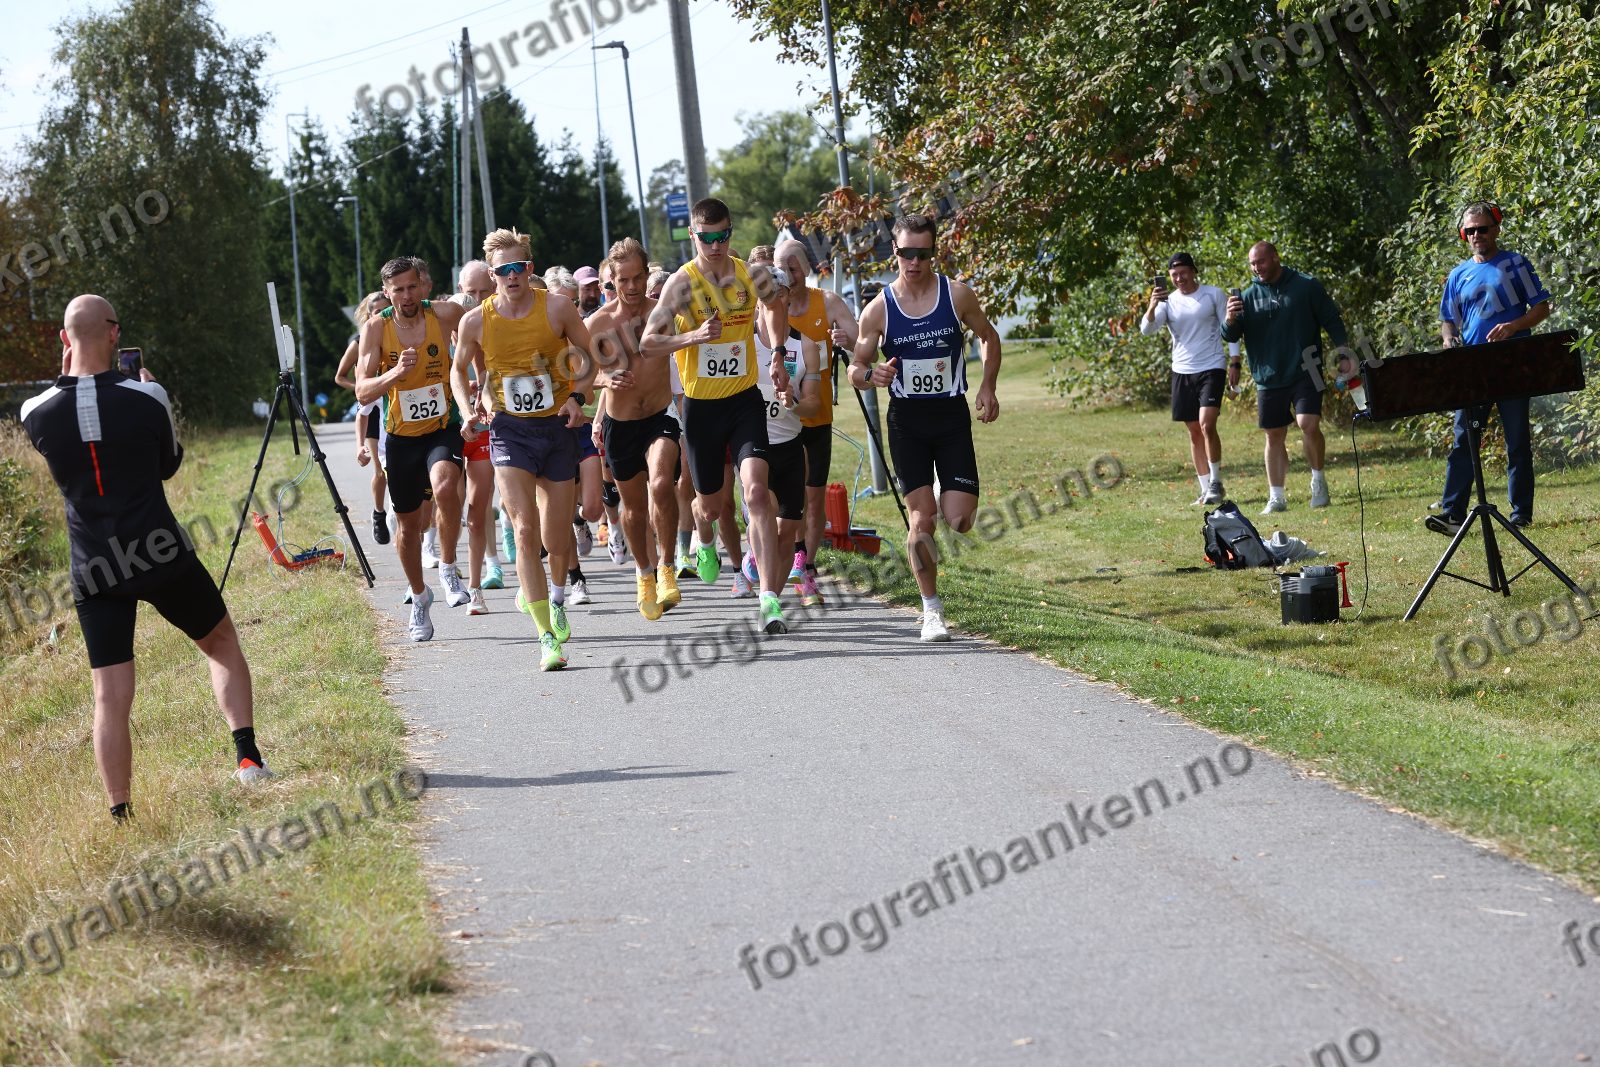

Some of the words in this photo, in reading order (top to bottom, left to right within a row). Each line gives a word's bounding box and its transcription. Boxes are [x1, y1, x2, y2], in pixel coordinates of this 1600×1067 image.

[893, 327, 954, 345] SPAREBANKEN
[916, 339, 934, 349] SØR
[707, 358, 739, 377] 942
[912, 374, 944, 393] 993
[409, 399, 440, 420] 252
[512, 392, 545, 412] 992
